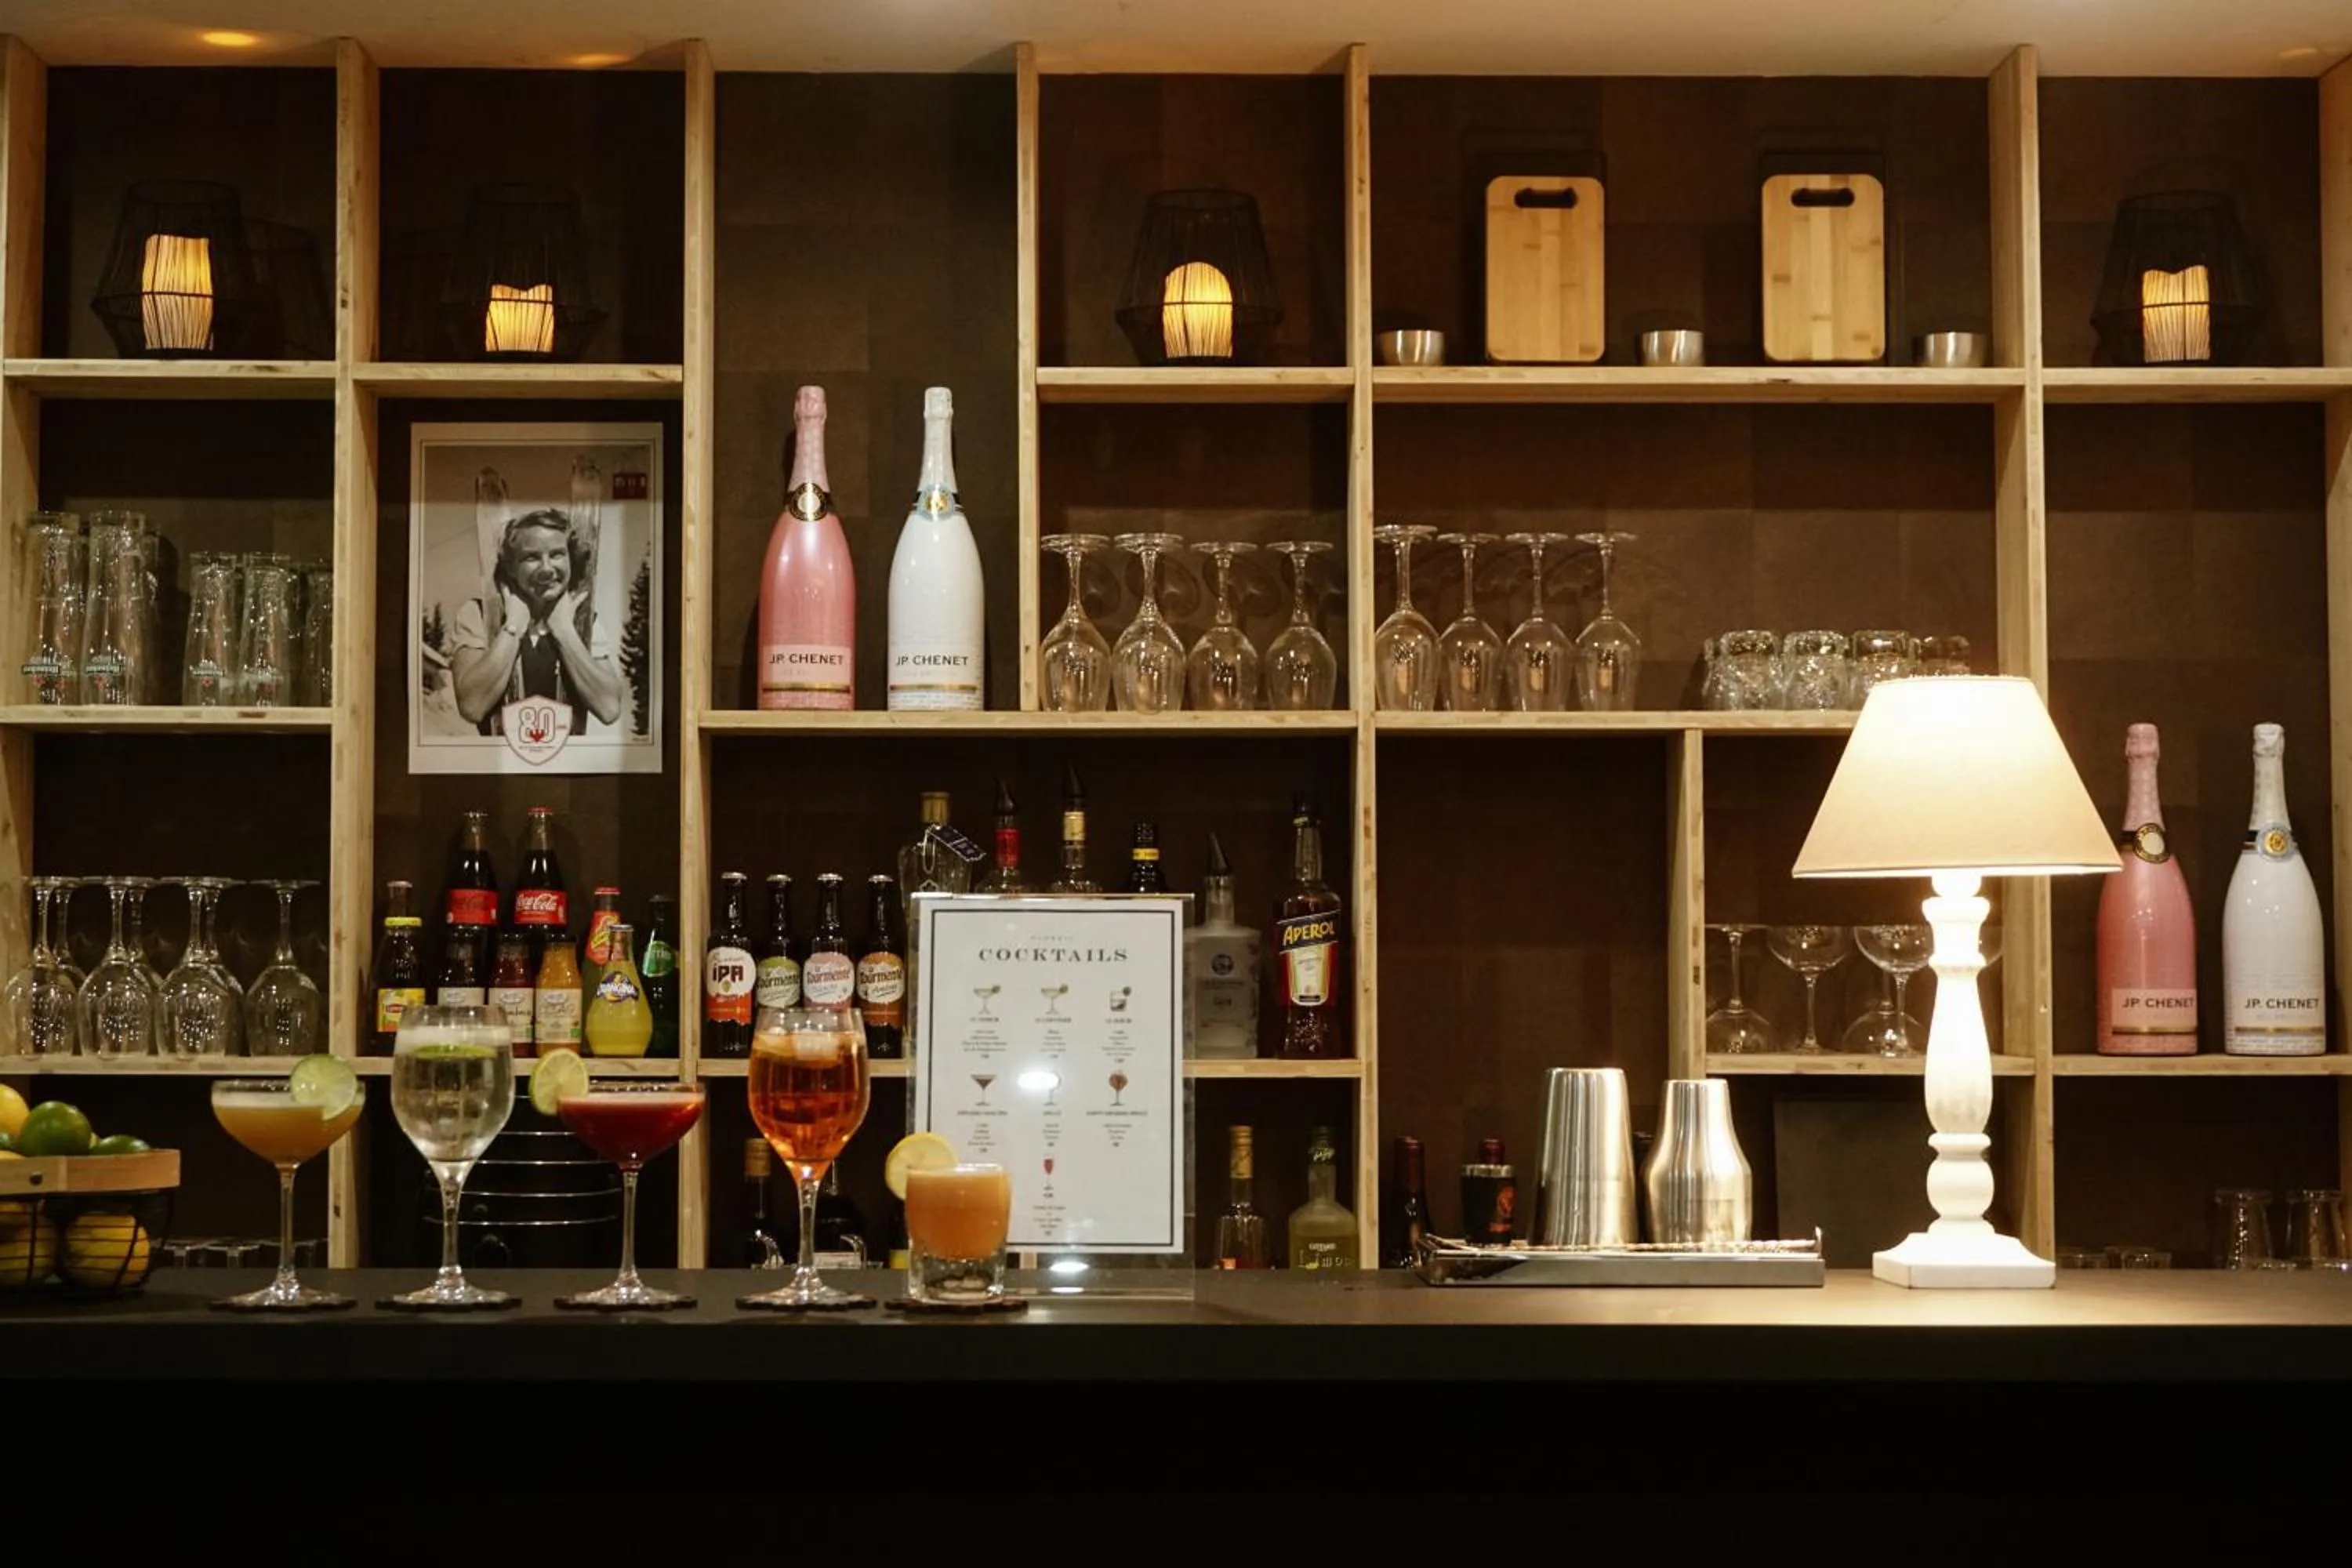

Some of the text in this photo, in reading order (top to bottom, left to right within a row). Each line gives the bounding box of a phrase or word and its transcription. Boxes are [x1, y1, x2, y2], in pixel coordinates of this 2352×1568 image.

[789, 653, 844, 666] CHENET
[913, 655, 969, 666] CHENET
[518, 706, 556, 744] 80
[1283, 920, 1335, 946] APEROL
[978, 948, 1128, 963] COCKTAILS
[2145, 997, 2194, 1009] CHENET
[2266, 998, 2319, 1010] CHENET
